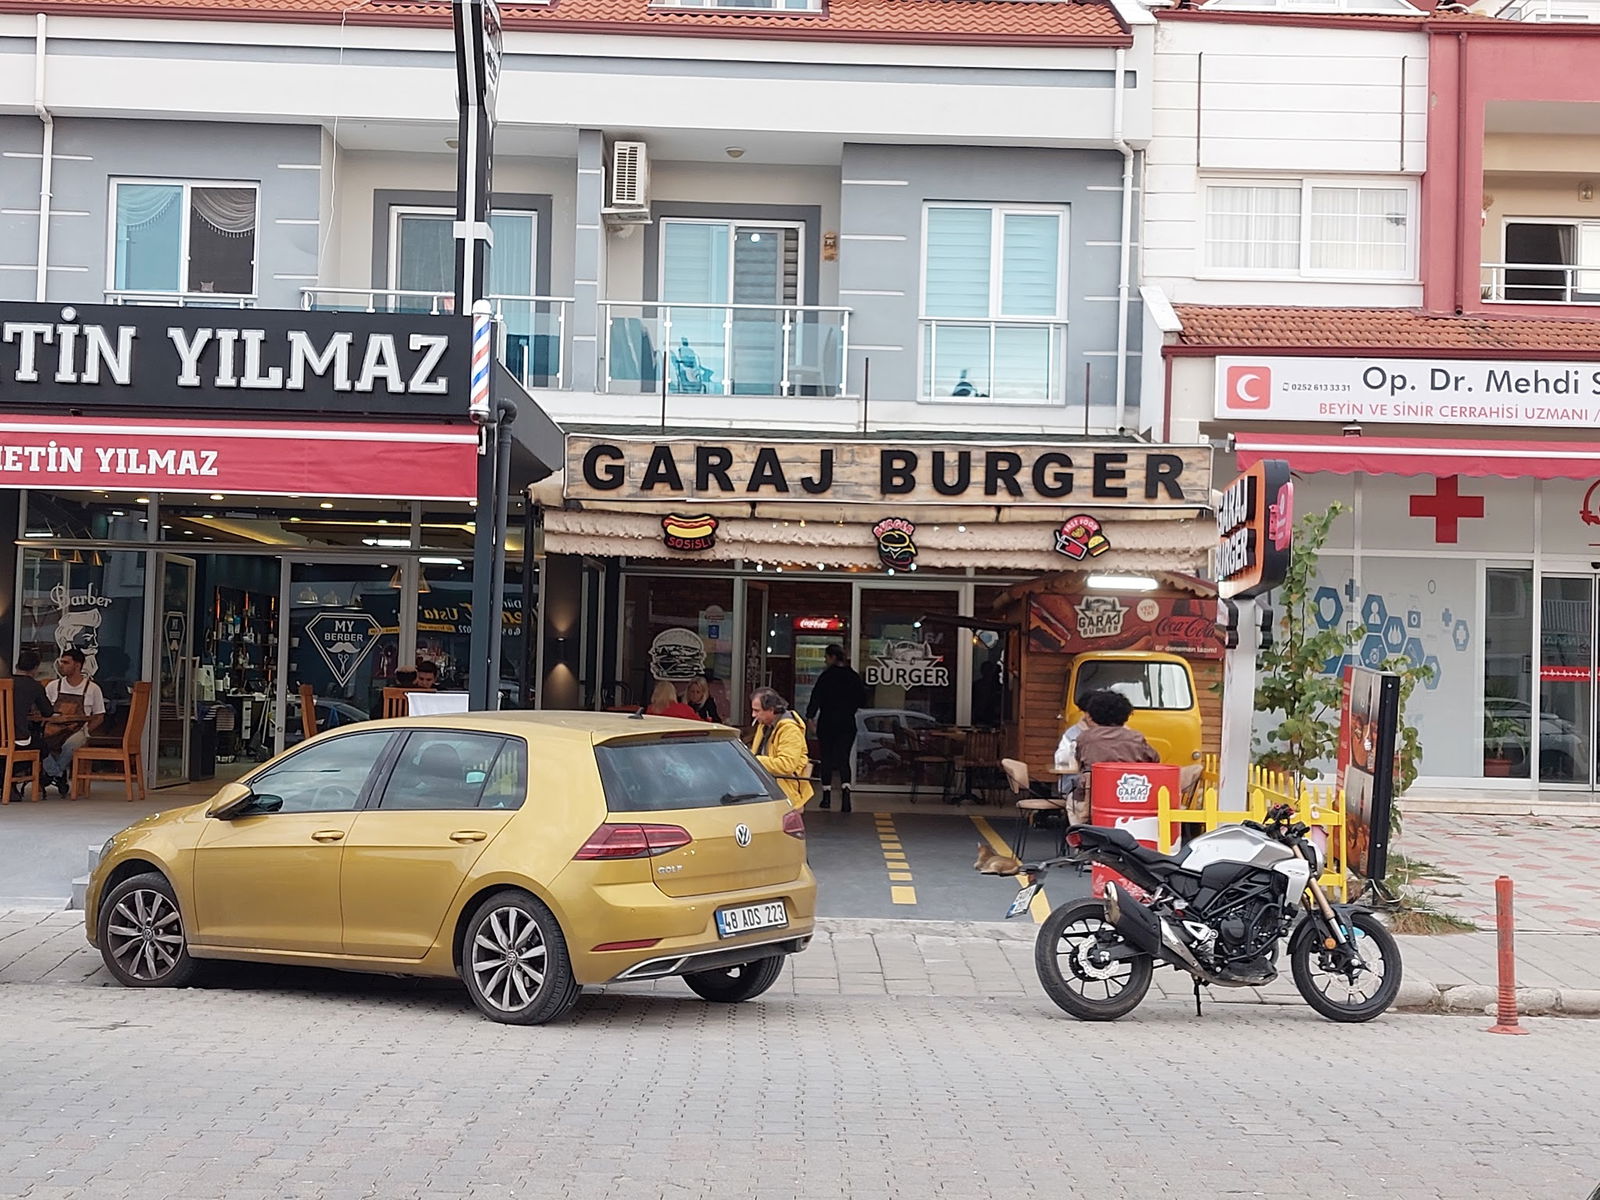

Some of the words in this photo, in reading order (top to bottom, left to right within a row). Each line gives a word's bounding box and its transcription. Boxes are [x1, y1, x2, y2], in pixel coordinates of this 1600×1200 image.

[167, 326, 449, 394] YILMAZ
[1363, 366, 1416, 397] Op.
[1430, 368, 1473, 393] Dr.
[1485, 369, 1579, 394] Mehdi
[1319, 400, 1364, 416] BEYİN
[1369, 403, 1388, 416] VE
[1393, 400, 1434, 418] SİNİR
[1439, 403, 1519, 420] CERRAHİSİ
[1524, 407, 1588, 421] UZMANI
[0, 441, 83, 472] ETİN
[96, 447, 218, 476] YILMAZ
[583, 444, 834, 495] GARAJ
[880, 449, 1185, 500] BURGER
[1217, 475, 1252, 536] GARAJ
[334, 620, 354, 632] MY
[1078, 613, 1121, 628] GARAJ
[1083, 626, 1118, 635] BURGER
[1156, 616, 1215, 638] Coca-Cola
[324, 632, 364, 642] BERBER
[867, 667, 947, 685] BURGER
[1118, 787, 1148, 796] GARAJ
[658, 865, 683, 874] GOLF
[724, 911, 738, 930] 48
[742, 908, 761, 927] ADS
[765, 904, 784, 923] 223
